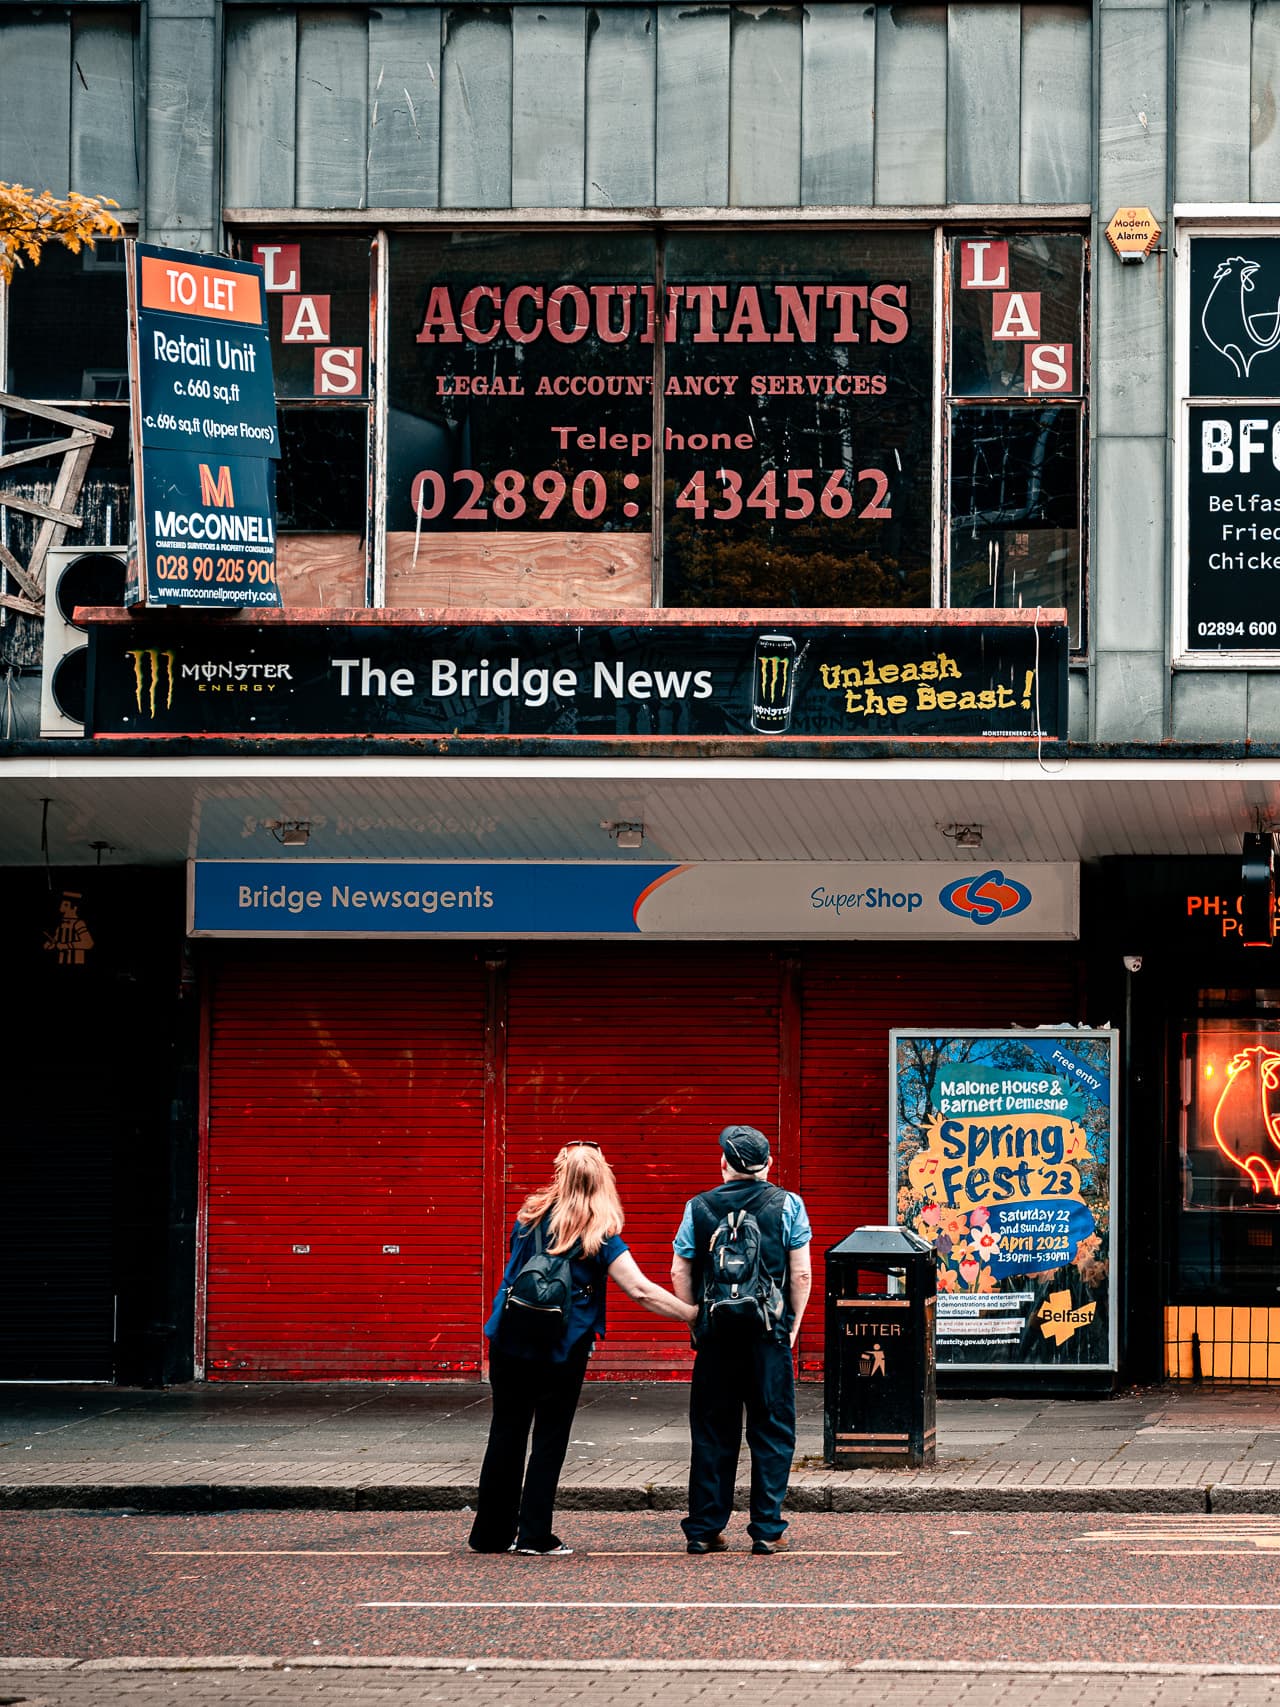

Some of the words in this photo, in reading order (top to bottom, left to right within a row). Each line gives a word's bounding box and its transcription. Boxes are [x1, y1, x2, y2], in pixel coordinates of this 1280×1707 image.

[1114, 219, 1150, 227] Modern
[1117, 232, 1148, 240] Alarms
[166, 269, 197, 306] TO
[203, 275, 237, 312] LET
[416, 285, 909, 345] ACCOUNTANTS
[153, 330, 211, 368] Retail
[216, 339, 256, 373] Unit
[213, 384, 240, 404] sq.ft
[436, 375, 525, 397] LEGAL
[751, 375, 888, 397] SERVICES
[178, 418, 201, 435] sq.ft
[202, 419, 238, 439] (Upper
[239, 422, 275, 444] Floors)
[551, 425, 754, 457] Telephone
[198, 463, 235, 508] M
[675, 469, 893, 521] 434562
[155, 540, 186, 549] CHARTERED
[187, 542, 216, 550] SURVEYORS
[221, 544, 244, 552] PROPERTY
[156, 554, 189, 581] 028
[192, 556, 214, 582] 90
[216, 558, 244, 583] 205
[1198, 621, 1246, 637] 02894
[1248, 621, 1277, 637] 600
[181, 660, 293, 681] MONSTER
[332, 659, 415, 698] The
[432, 657, 578, 708] Bridge
[594, 661, 713, 699] News
[819, 652, 962, 690] Unleash
[198, 683, 276, 692] ENERGY
[845, 687, 908, 716] the
[238, 885, 322, 914] Bridge
[332, 885, 495, 914] Newsagents
[811, 886, 923, 916] SuperShop
[1186, 896, 1228, 916] PH:
[1052, 1050, 1076, 1073] Free
[1074, 1067, 1102, 1089] entry
[940, 1080, 1000, 1097] Malone
[1001, 1079, 1049, 1095] House
[1050, 1080, 1064, 1095] &
[940, 1096, 1004, 1113] Barnett
[1005, 1096, 1068, 1111] Demesne
[939, 1120, 1065, 1168] Spring
[941, 1160, 1036, 1206] Fest
[998, 1208, 1054, 1223] Saturday
[1056, 1210, 1071, 1222] 22
[1000, 1223, 1018, 1235] and
[1020, 1222, 1057, 1234] Sunday
[1057, 1224, 1070, 1234] 23
[1000, 1236, 1033, 1253] April
[1036, 1236, 1070, 1251] 2023
[1042, 1309, 1095, 1323] Belfast
[846, 1323, 901, 1336] LITTER
